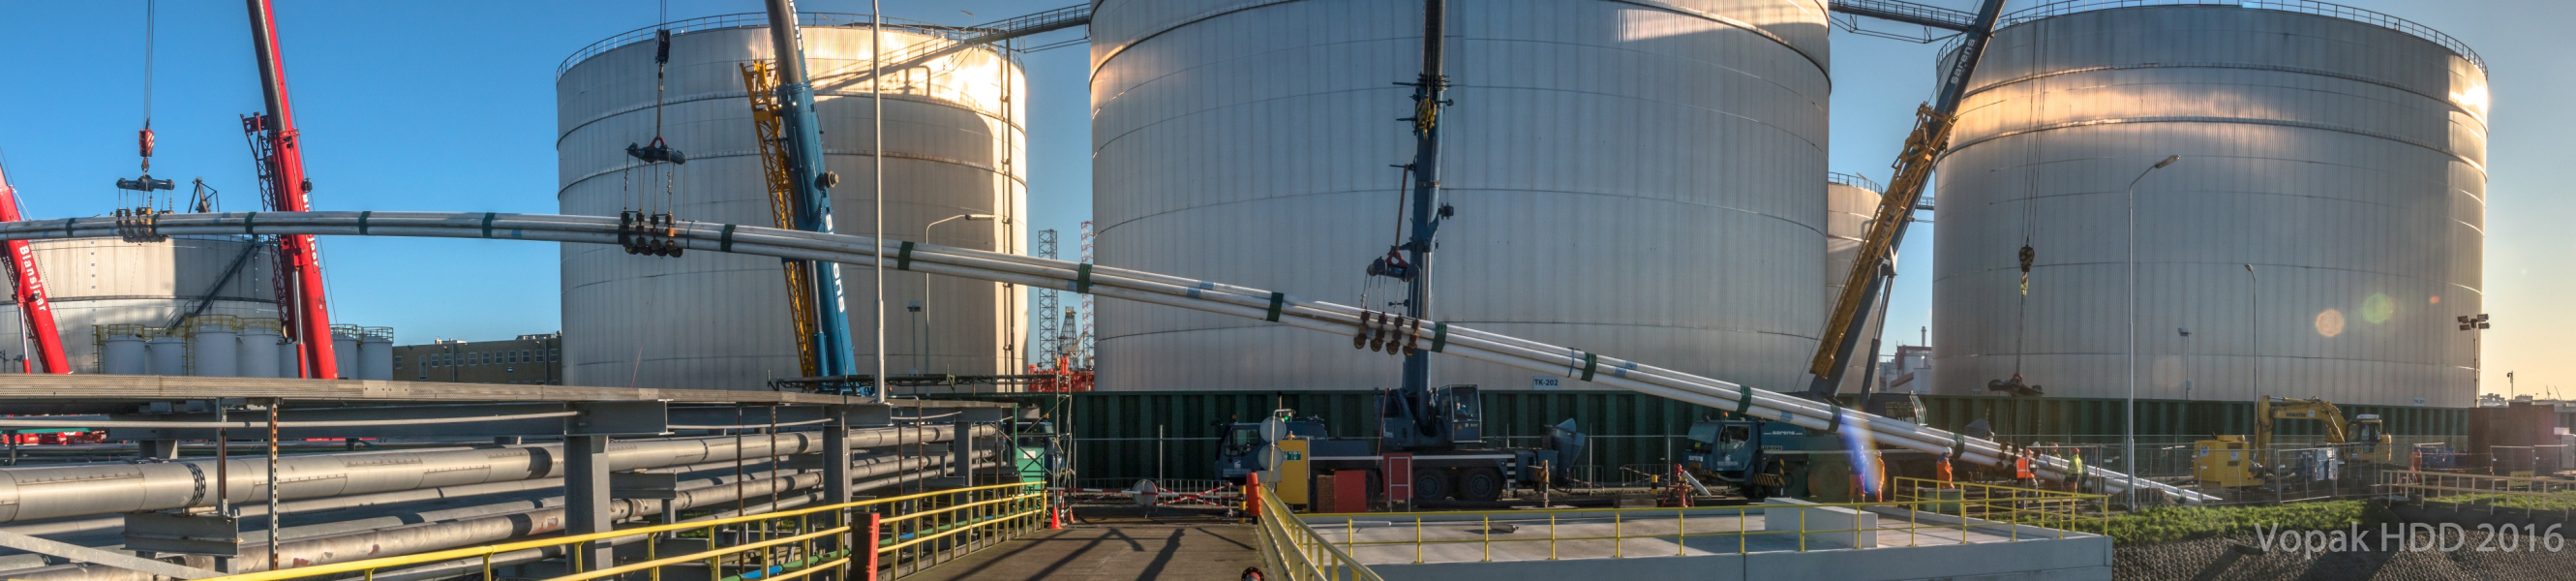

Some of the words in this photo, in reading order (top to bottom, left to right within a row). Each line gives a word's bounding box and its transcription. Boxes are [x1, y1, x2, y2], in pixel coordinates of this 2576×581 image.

[789, 0, 803, 50] rens
[1951, 39, 1975, 84] sarens
[302, 194, 318, 266] Bljaar
[826, 214, 845, 313] sens
